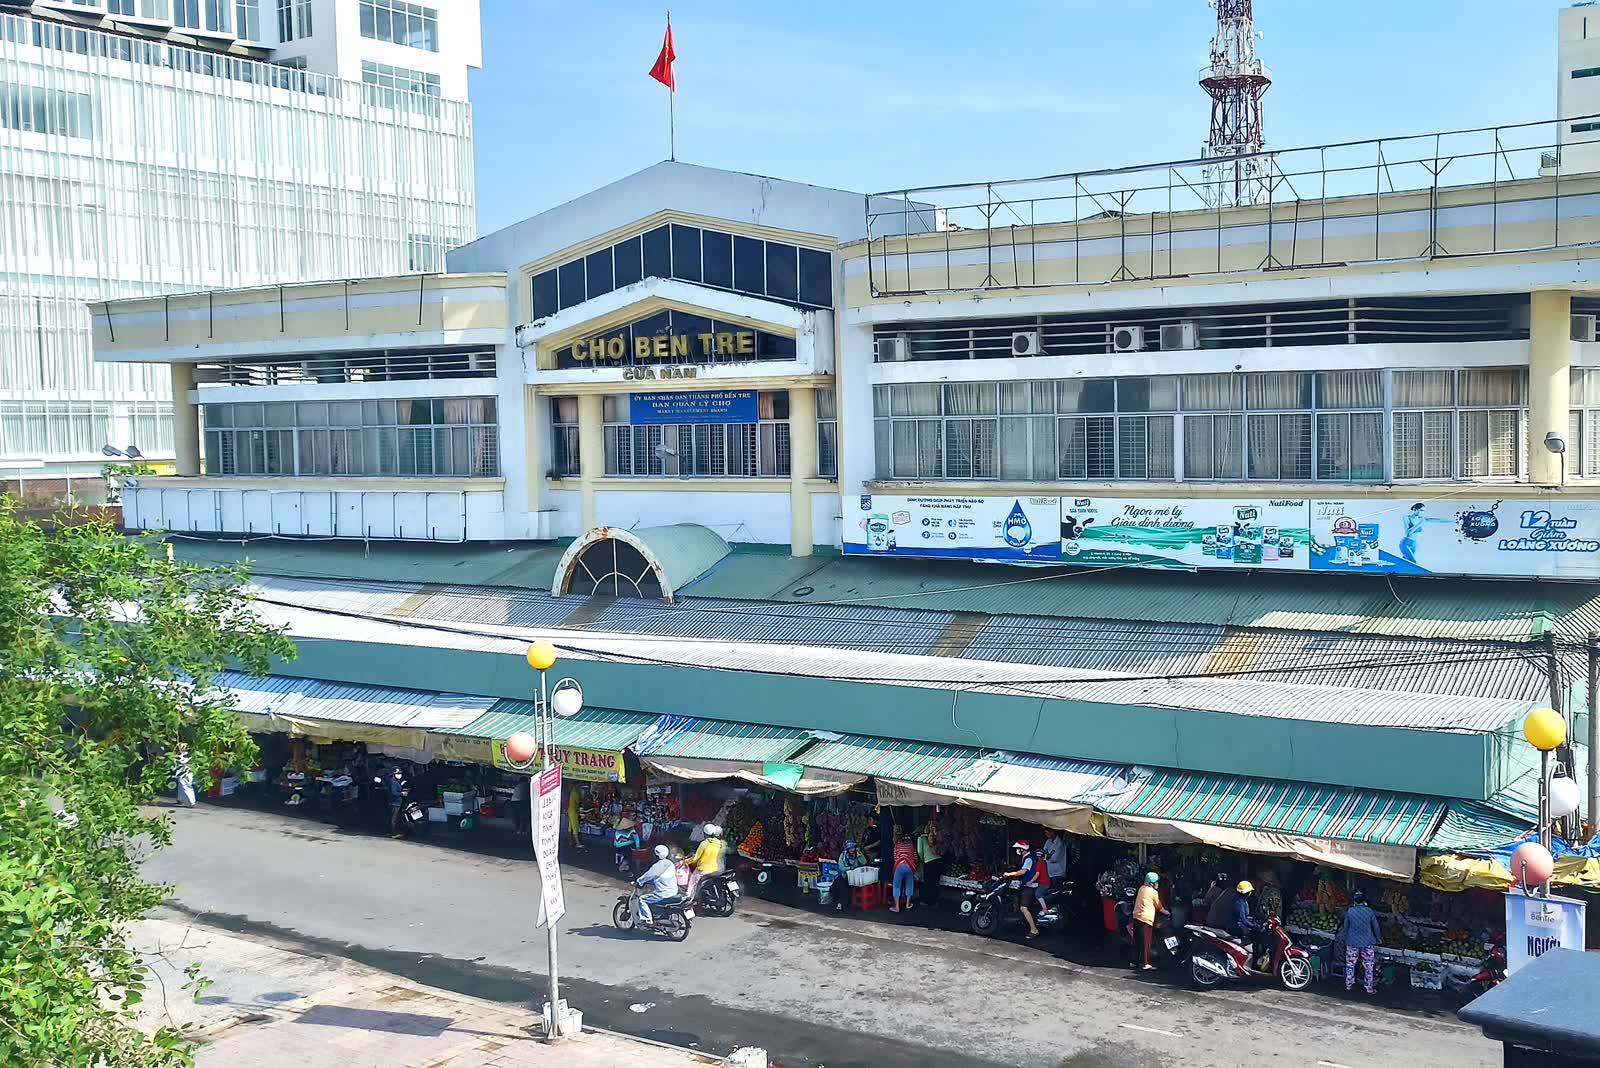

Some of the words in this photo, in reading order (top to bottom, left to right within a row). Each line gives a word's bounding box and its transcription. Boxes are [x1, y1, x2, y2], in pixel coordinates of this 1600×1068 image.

[698, 331, 754, 354] TRE
[660, 367, 697, 379] NAM
[1124, 504, 1153, 518] Ngon
[1171, 505, 1183, 519] ly
[1239, 509, 1257, 520] Nuti
[1007, 517, 1027, 526] HMO
[1111, 516, 1136, 528] Giàu
[1138, 517, 1161, 528] dinh
[1521, 510, 1550, 528] 12
[1547, 539, 1599, 552] XƯƠNG
[573, 751, 616, 768] TRANG
